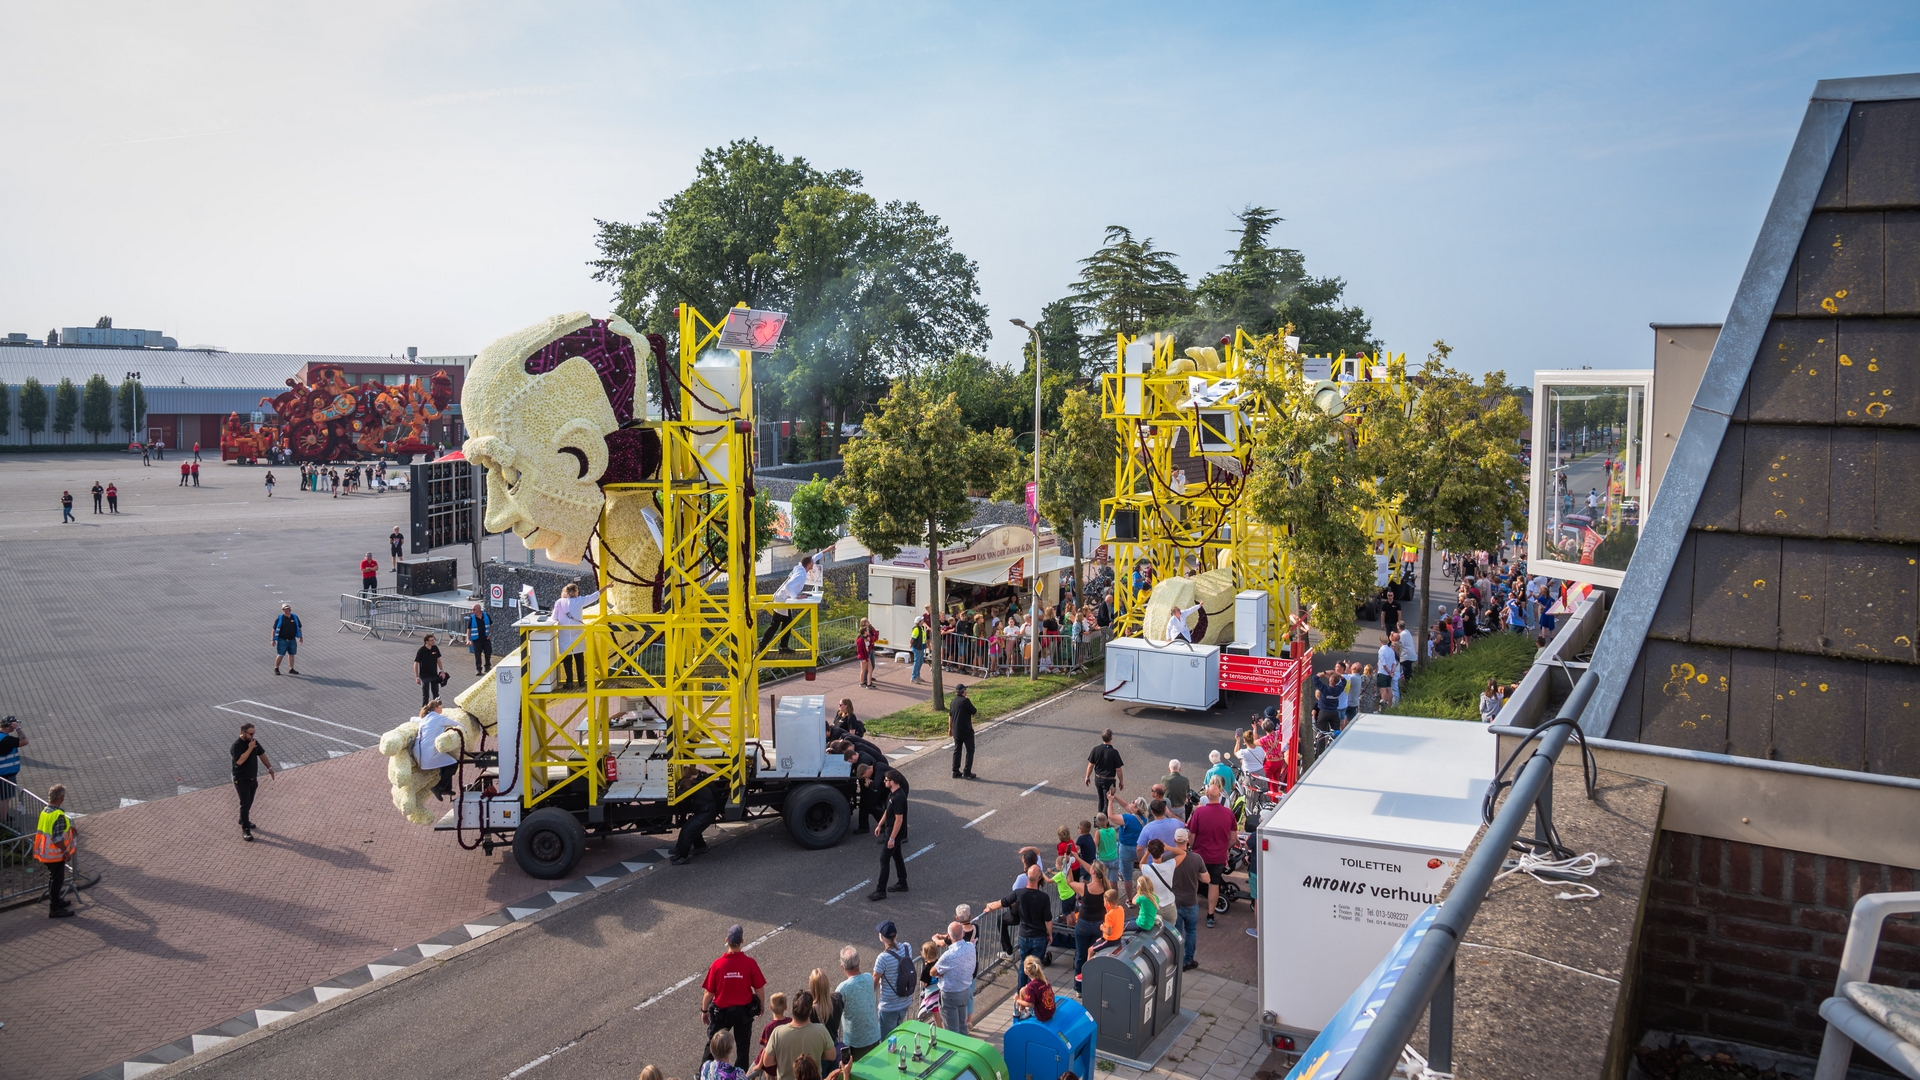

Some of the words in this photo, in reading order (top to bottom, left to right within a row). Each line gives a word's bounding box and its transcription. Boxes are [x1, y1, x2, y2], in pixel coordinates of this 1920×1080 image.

[997, 549, 1006, 557] DER
[1262, 668, 1286, 676] toilett
[1340, 857, 1402, 873] TOILETTEN
[1302, 875, 1367, 895] ANTONIS
[1366, 907, 1375, 916] Tel.
[1375, 909, 1409, 921] 013-5092237
